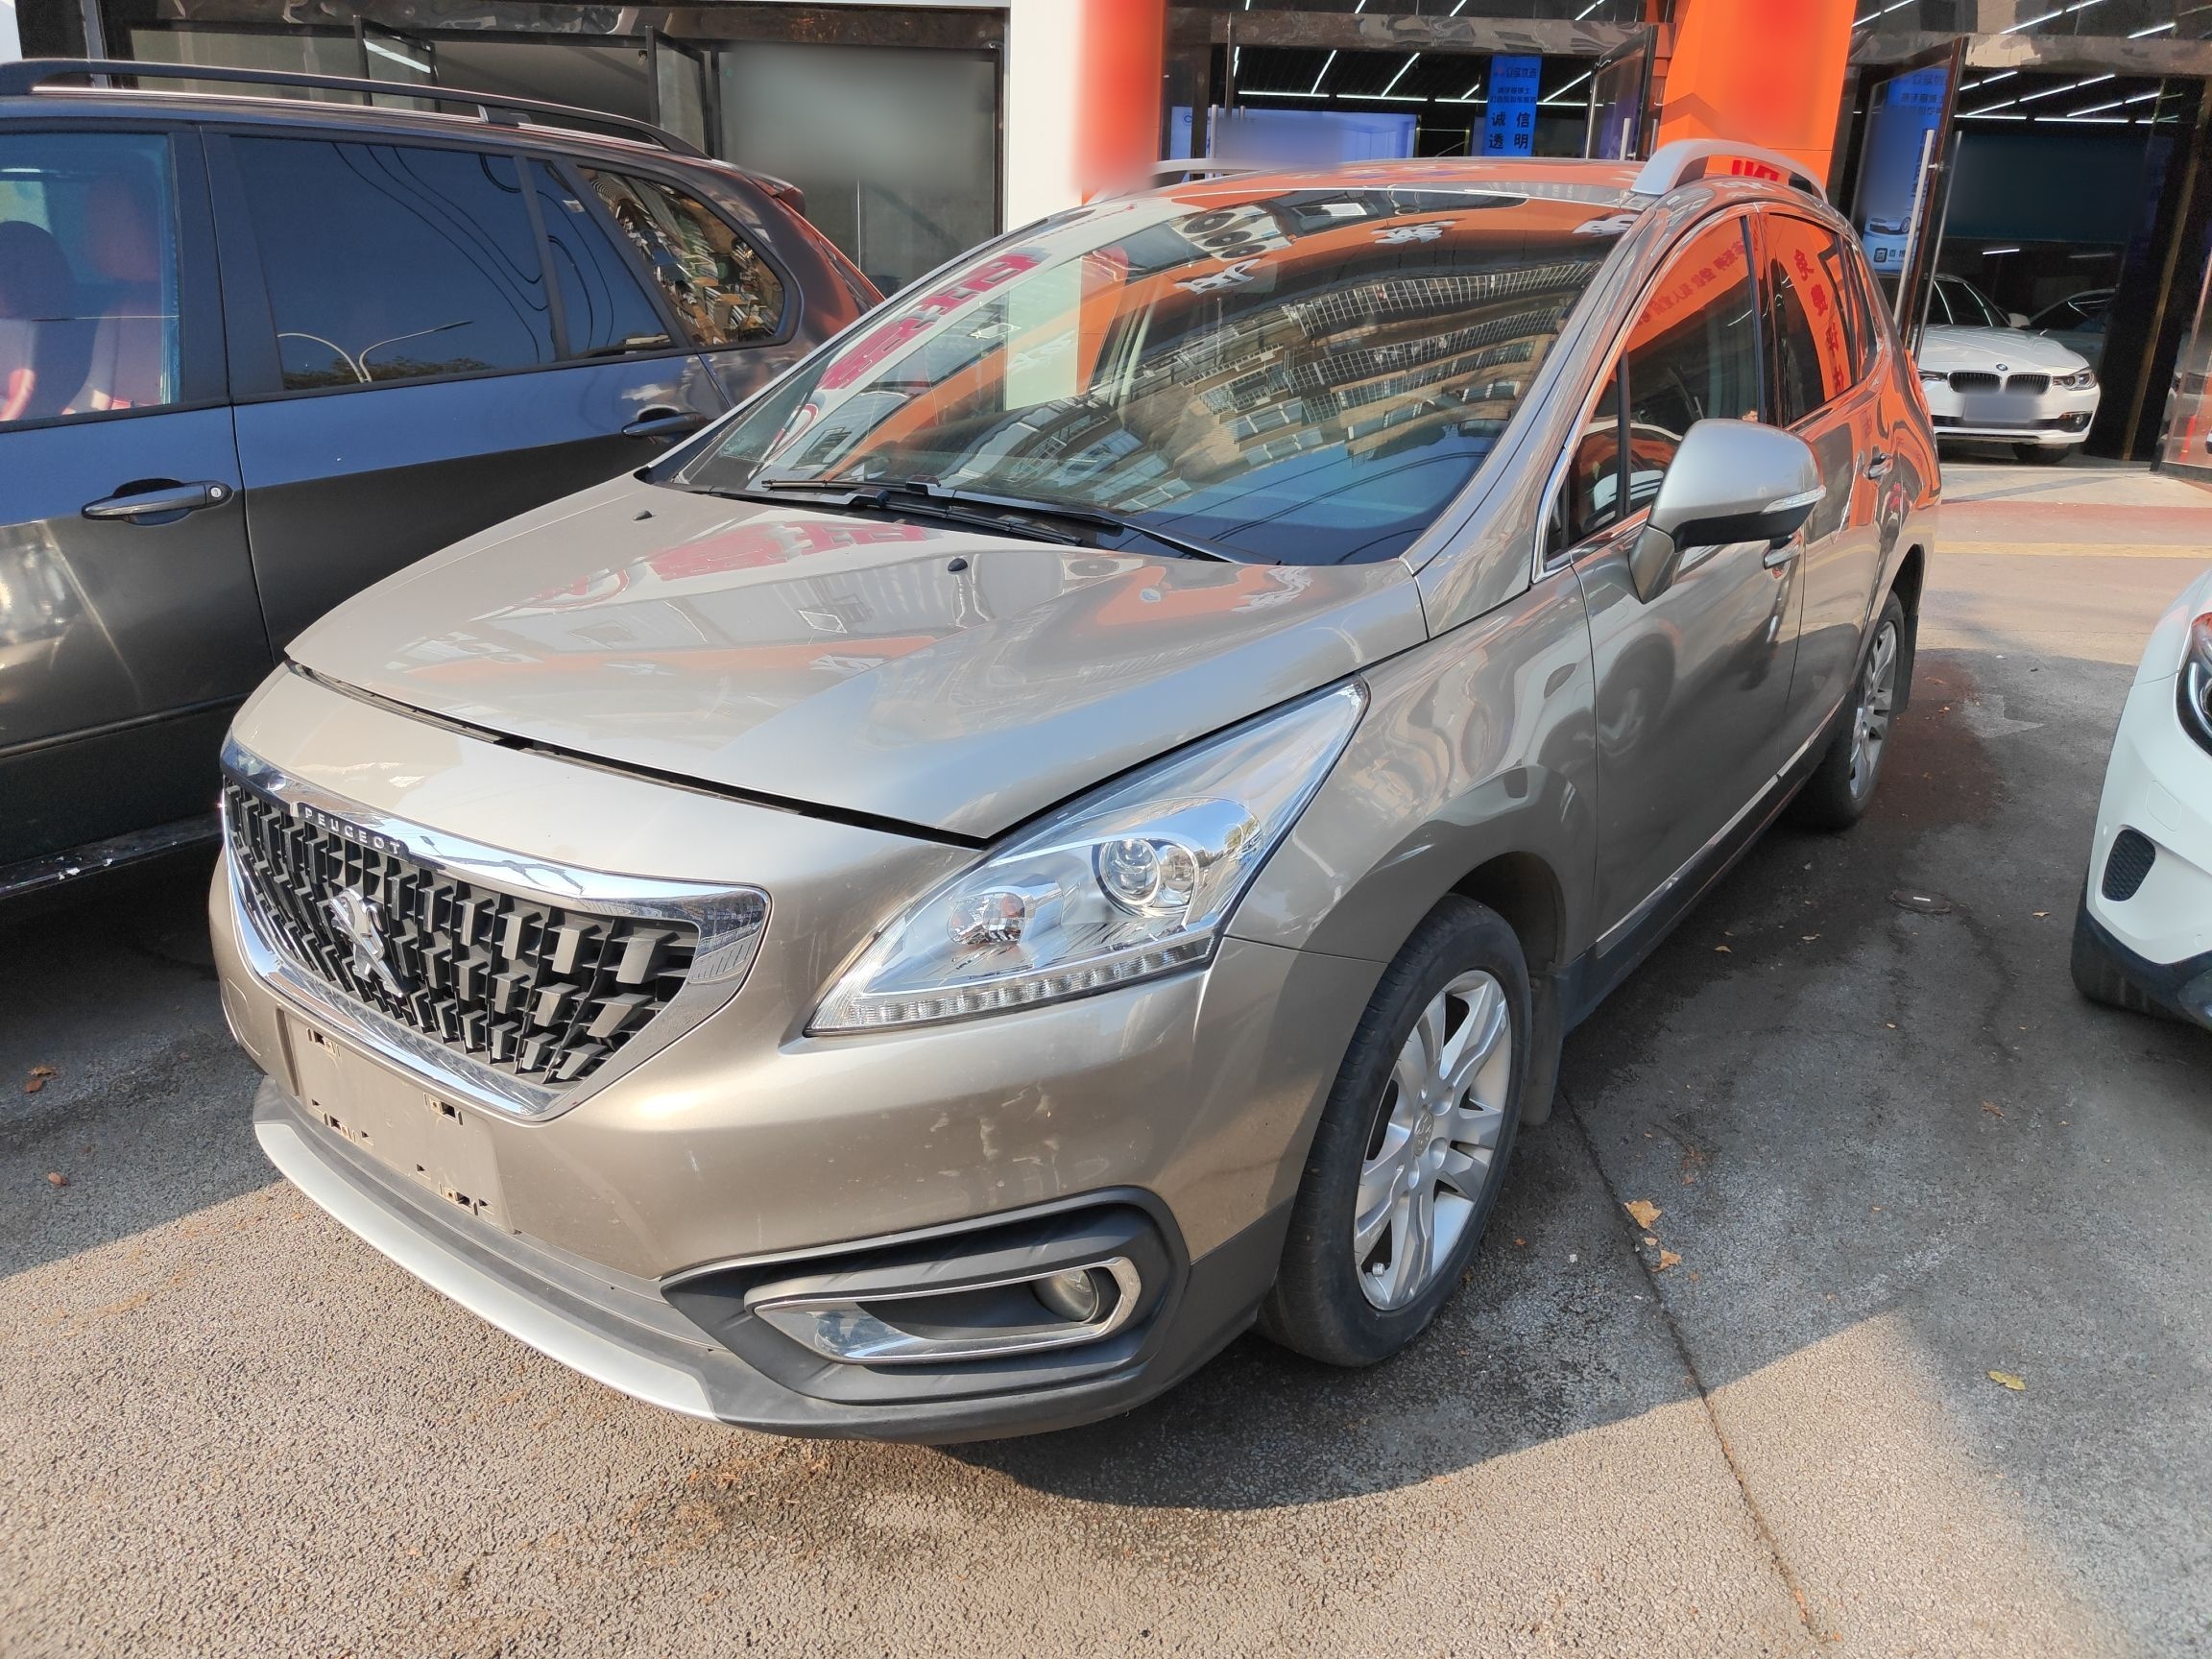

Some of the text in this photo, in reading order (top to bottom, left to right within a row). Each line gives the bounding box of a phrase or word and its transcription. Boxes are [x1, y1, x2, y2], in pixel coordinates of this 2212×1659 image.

[1491, 111, 1530, 128] 诚信
[1488, 133, 1528, 149] 透明
[304, 806, 400, 854] PEUGEOT
